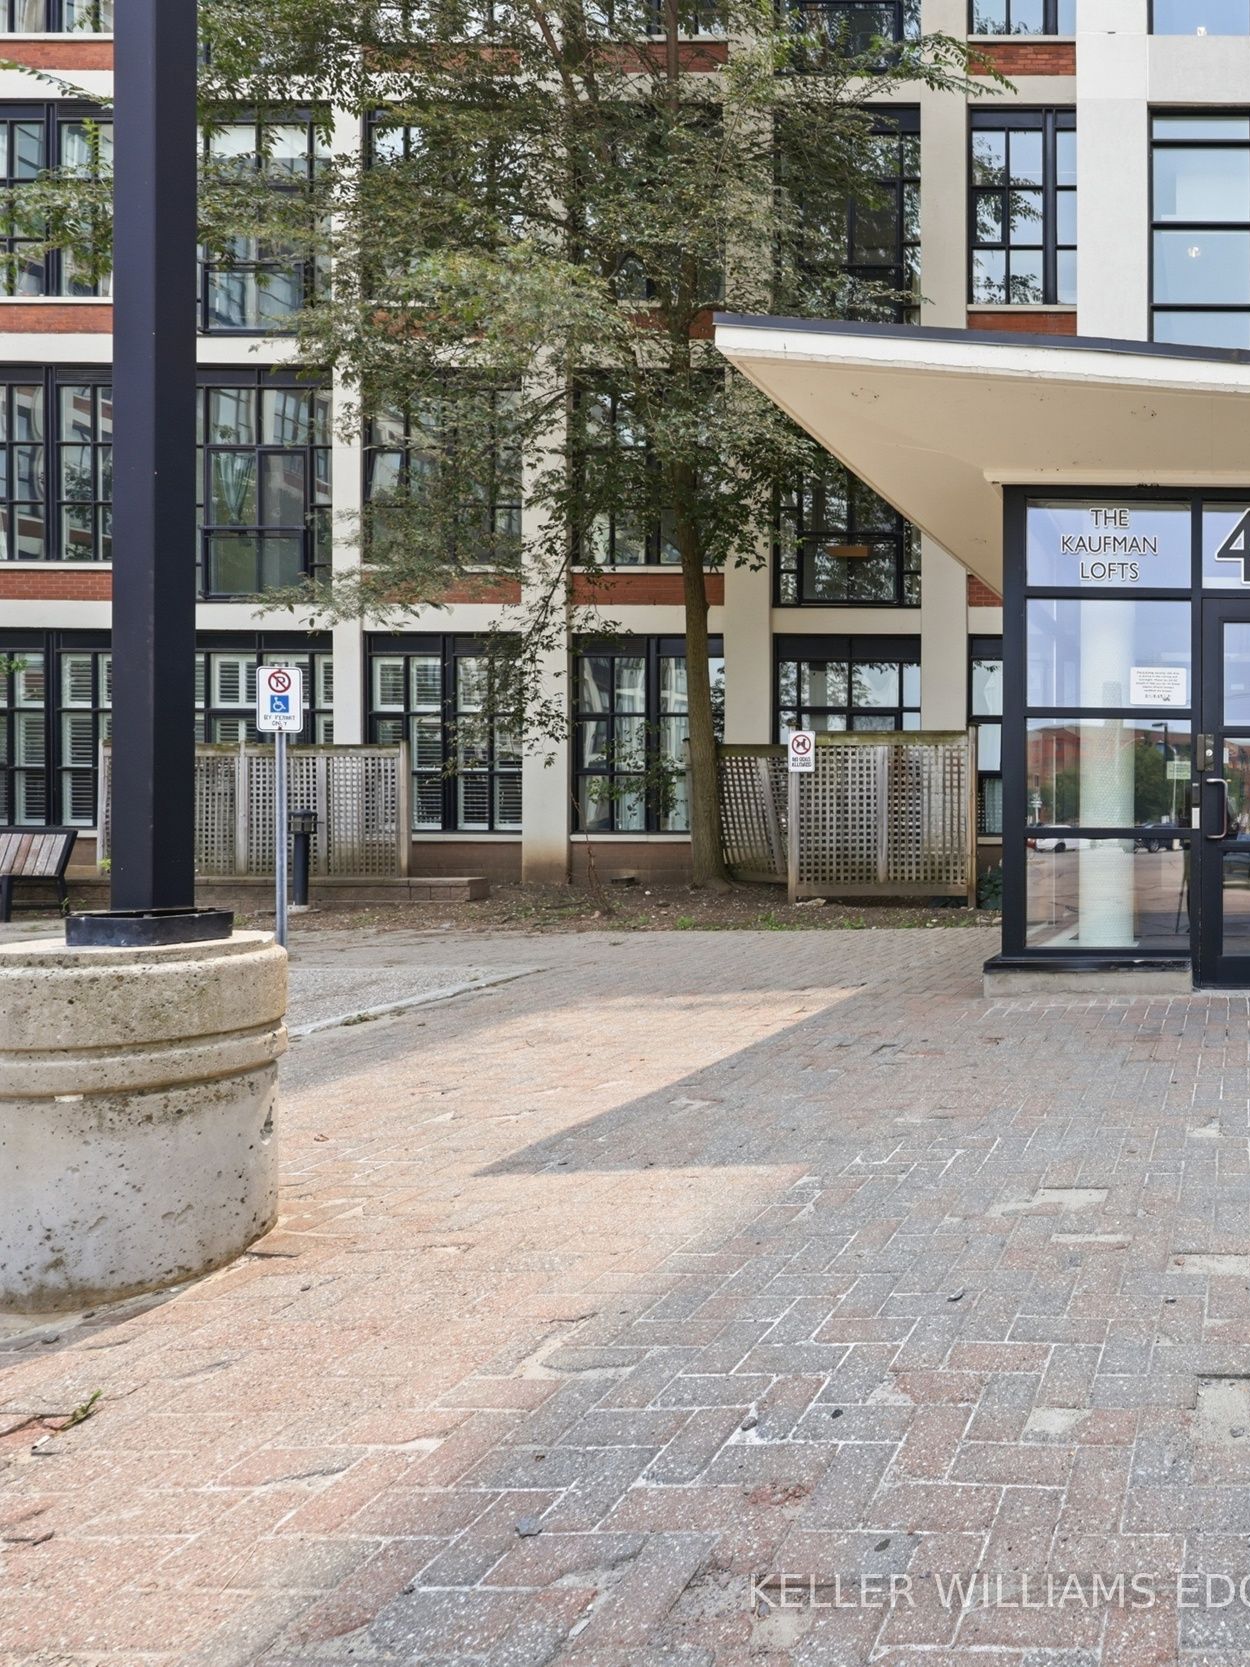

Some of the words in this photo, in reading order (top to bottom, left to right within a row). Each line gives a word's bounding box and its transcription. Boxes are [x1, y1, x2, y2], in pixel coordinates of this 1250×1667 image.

[1089, 508, 1130, 528] THE
[1060, 534, 1158, 554] KAUFMAN
[1080, 561, 1140, 581] LOFTS
